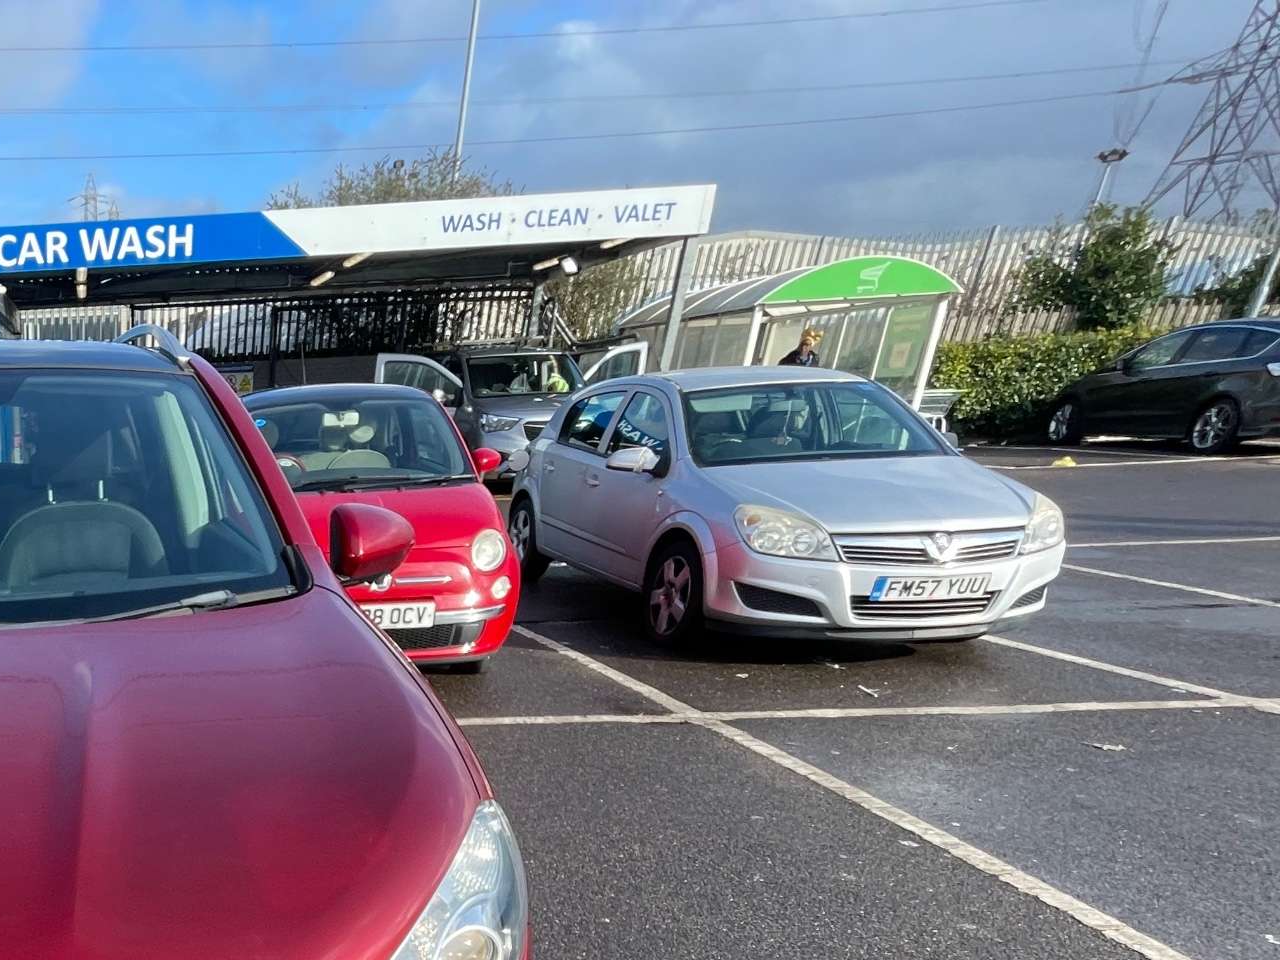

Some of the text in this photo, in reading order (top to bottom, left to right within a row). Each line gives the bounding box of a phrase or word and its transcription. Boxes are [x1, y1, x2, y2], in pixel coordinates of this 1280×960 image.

[441, 202, 677, 233] WASH CLEAN VALET
[79, 224, 194, 261] WASH
[884, 577, 985, 597] FM57 YUU
